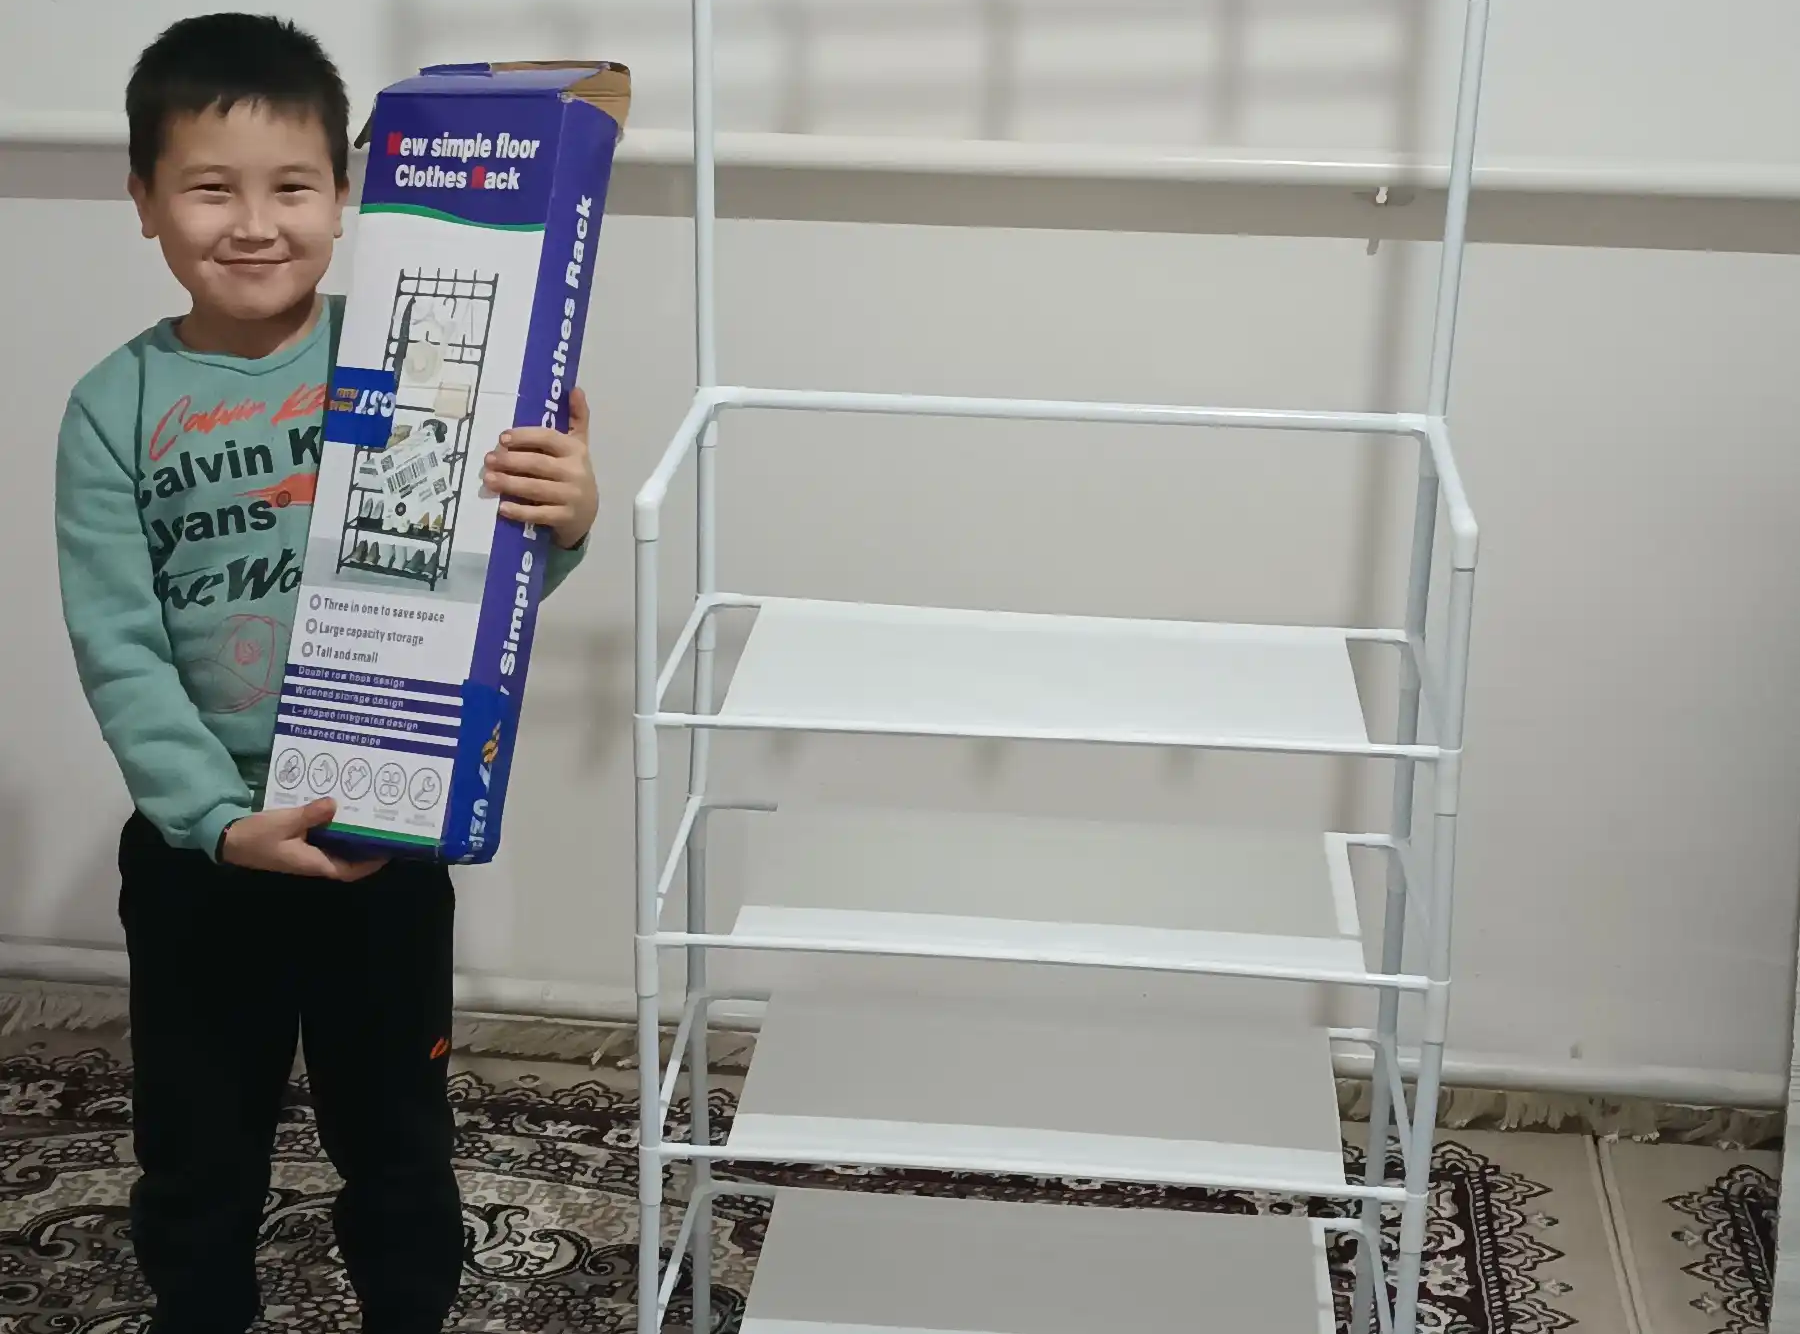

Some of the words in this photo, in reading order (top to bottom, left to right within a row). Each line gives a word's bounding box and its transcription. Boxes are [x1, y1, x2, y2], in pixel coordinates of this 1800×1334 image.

[387, 131, 428, 157] New
[430, 131, 492, 163] simple
[496, 132, 540, 159] floor
[395, 164, 468, 189] Clothes
[471, 166, 521, 190] Rack
[565, 194, 593, 289] Rack
[324, 597, 349, 611] Three
[350, 599, 360, 613] in
[361, 605, 379, 615] one
[381, 604, 391, 616] to
[392, 608, 415, 619] save
[416, 610, 445, 622] space
[500, 550, 534, 676] Simple
[319, 621, 345, 637] Large
[346, 627, 386, 642] capacity
[387, 631, 424, 646] storage
[316, 644, 333, 659] Tall
[334, 648, 351, 660] and
[352, 651, 379, 663] small
[298, 666, 330, 678] Double
[373, 676, 405, 688] design
[295, 685, 334, 699] Widened
[334, 691, 371, 703] storage
[372, 696, 404, 708] design
[336, 712, 385, 726] integrated
[386, 719, 418, 731] design
[290, 724, 335, 740] Thickened
[361, 737, 381, 746] pipe
